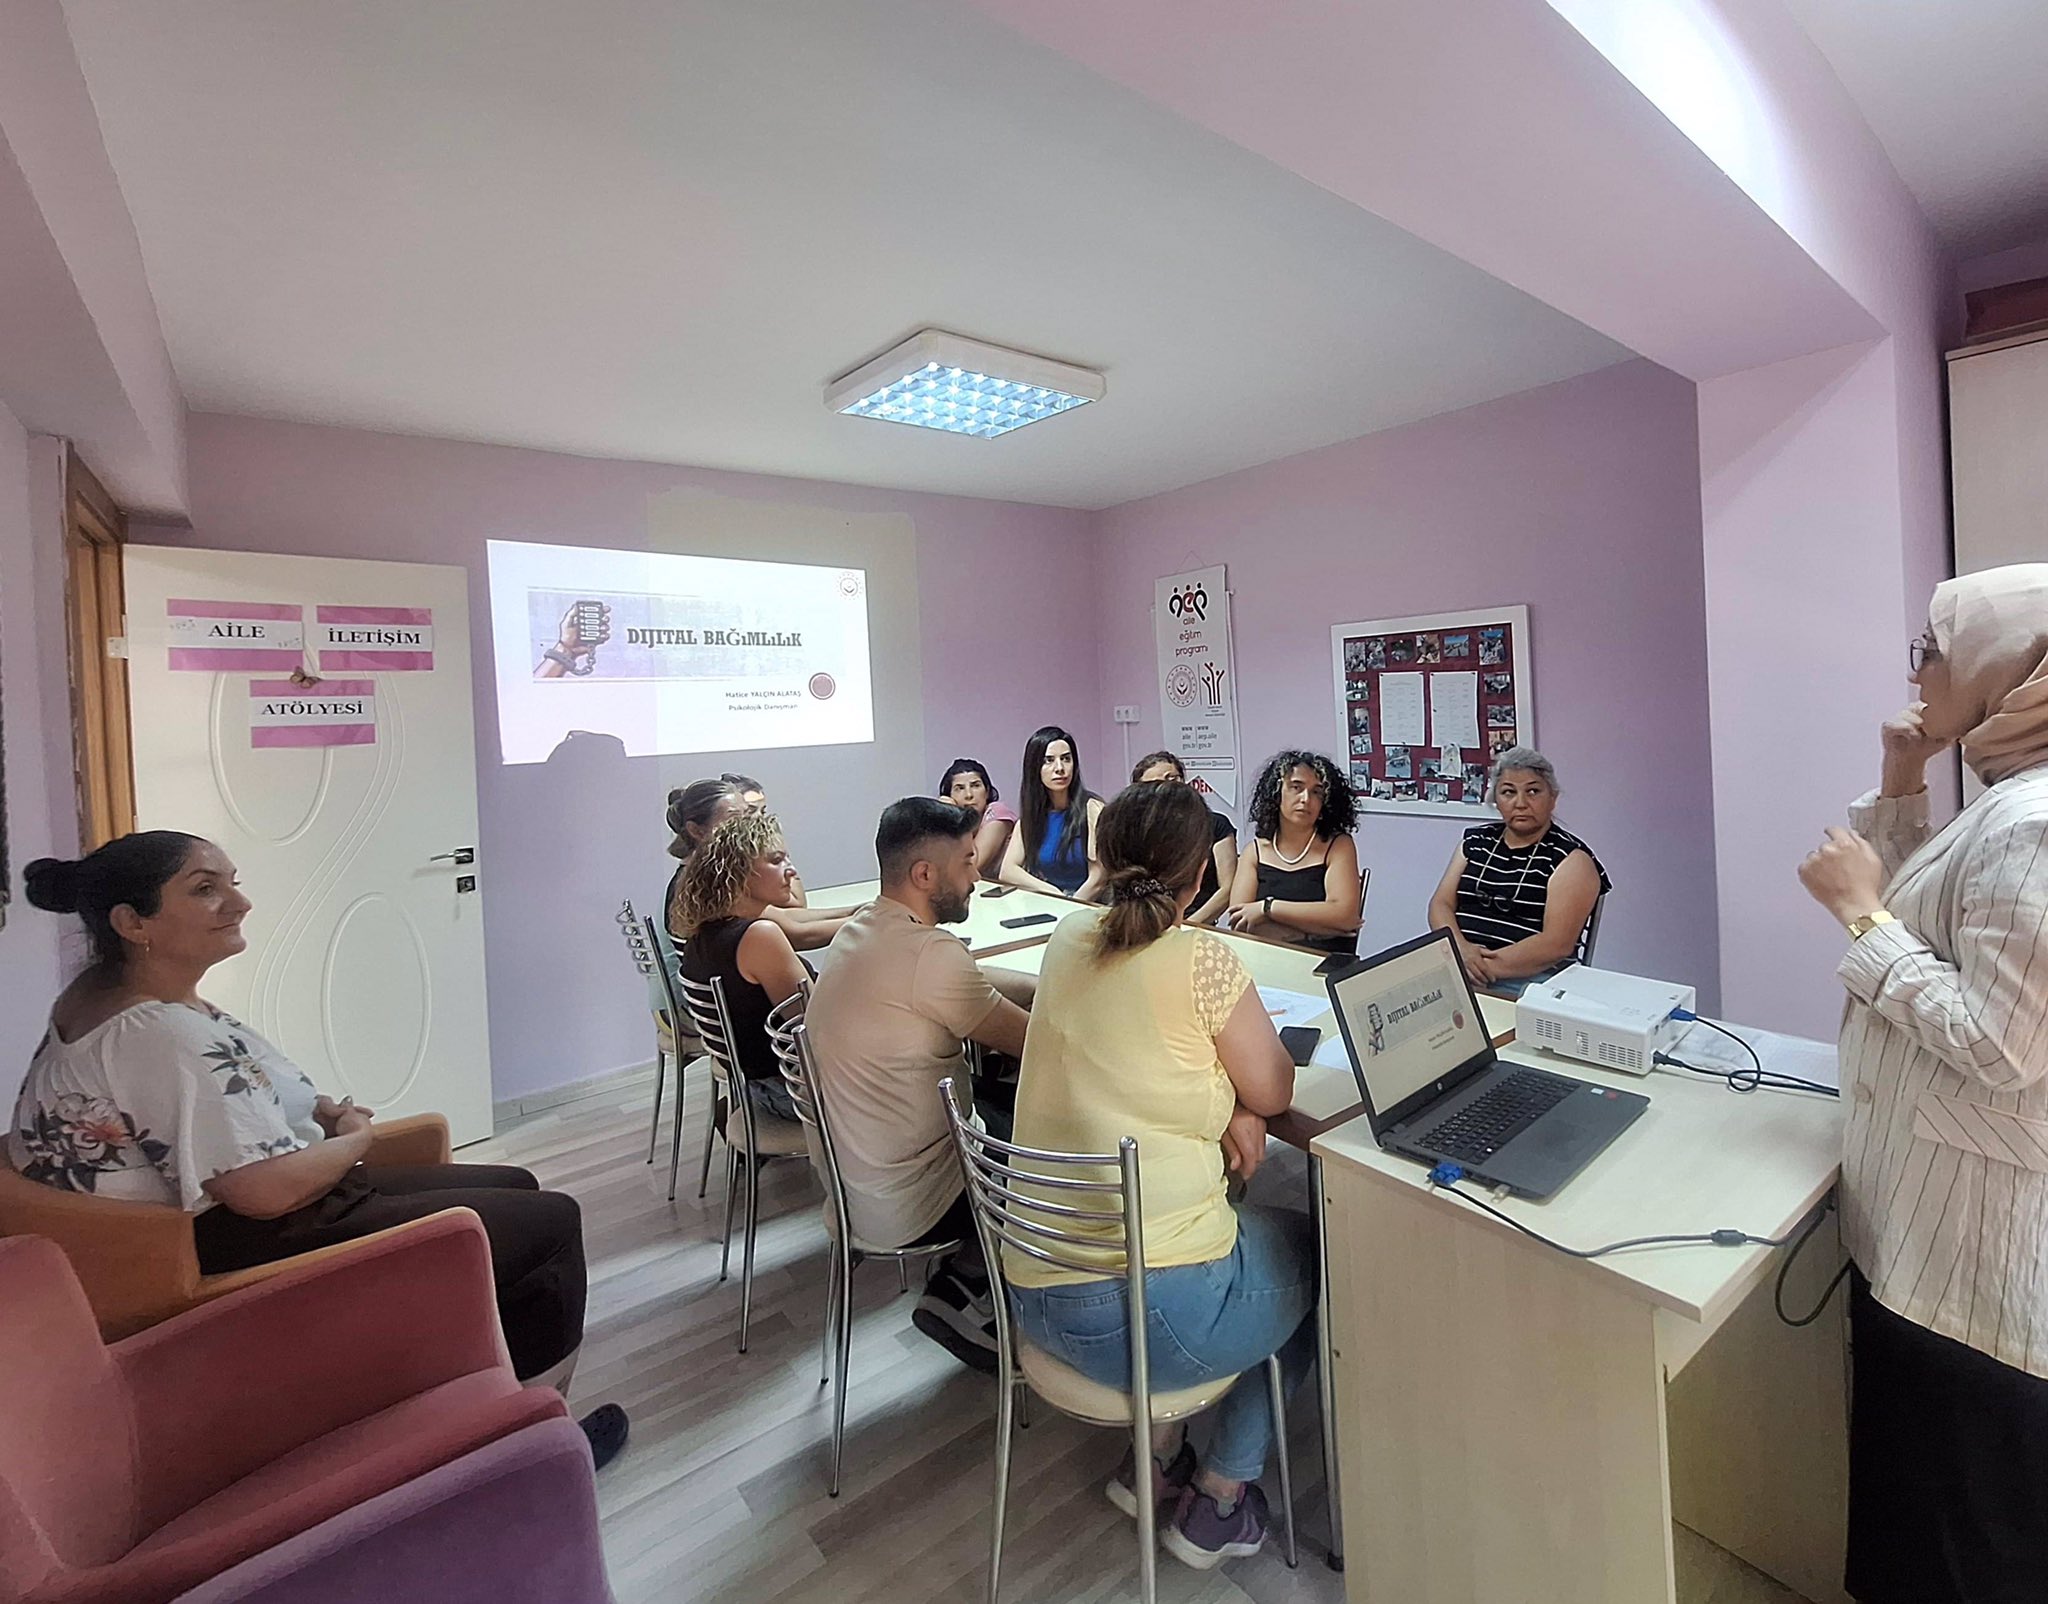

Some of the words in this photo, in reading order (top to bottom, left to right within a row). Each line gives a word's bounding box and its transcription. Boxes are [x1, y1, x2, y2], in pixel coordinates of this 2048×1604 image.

[208, 622, 265, 639] AİLE
[328, 628, 421, 646] İLETİŞİM
[261, 701, 364, 715] ATÖLYESİ
